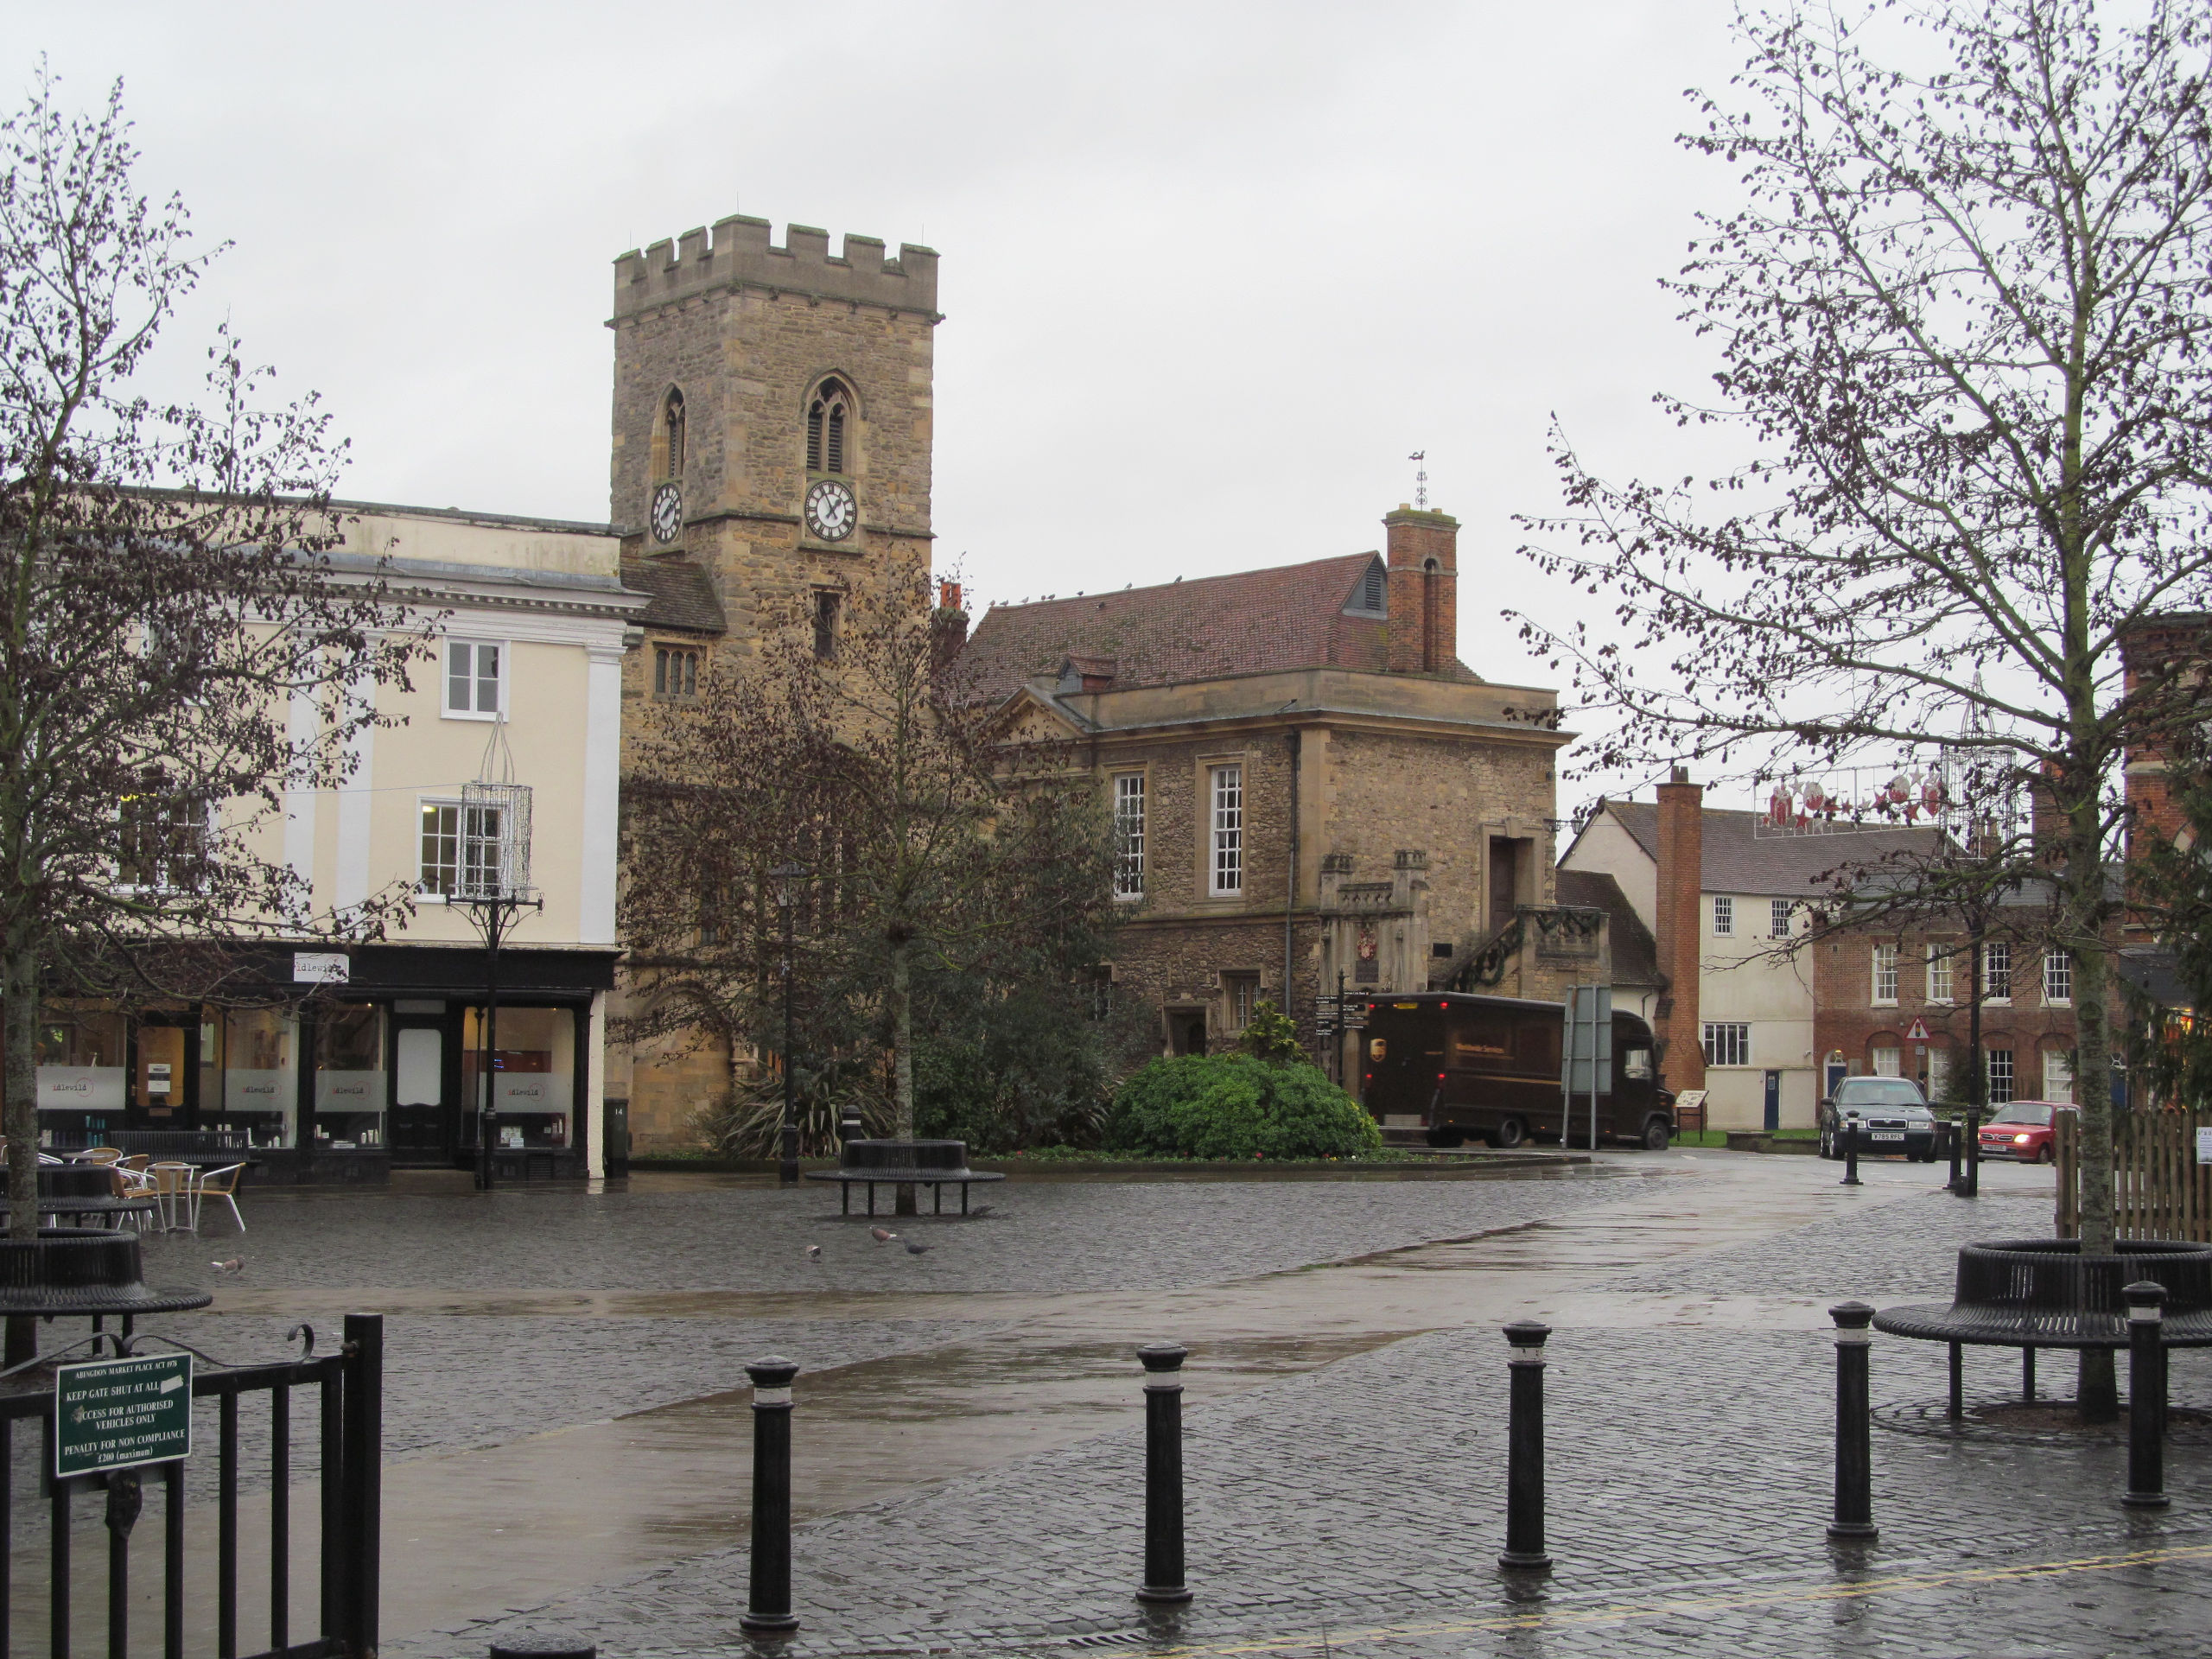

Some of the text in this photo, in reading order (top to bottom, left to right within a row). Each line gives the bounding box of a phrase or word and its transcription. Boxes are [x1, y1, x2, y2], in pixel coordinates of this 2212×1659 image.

[53, 1082, 87, 1091] idlewild
[75, 1370, 107, 1379] ABINGDON
[135, 1363, 153, 1371] PLACE
[67, 1391, 87, 1402] KEEP
[89, 1388, 109, 1399] GATE
[111, 1385, 132, 1395] SHUT
[134, 1383, 143, 1393] AT
[144, 1381, 160, 1391] ALL
[78, 1400, 174, 1421] CCESS FOR AUTHORISED
[96, 1413, 156, 1429] VEHICLES ONLY
[65, 1429, 185, 1455] PENALTY FOR NON COMPLIANCE
[98, 1446, 153, 1463] £200 (maximum)
